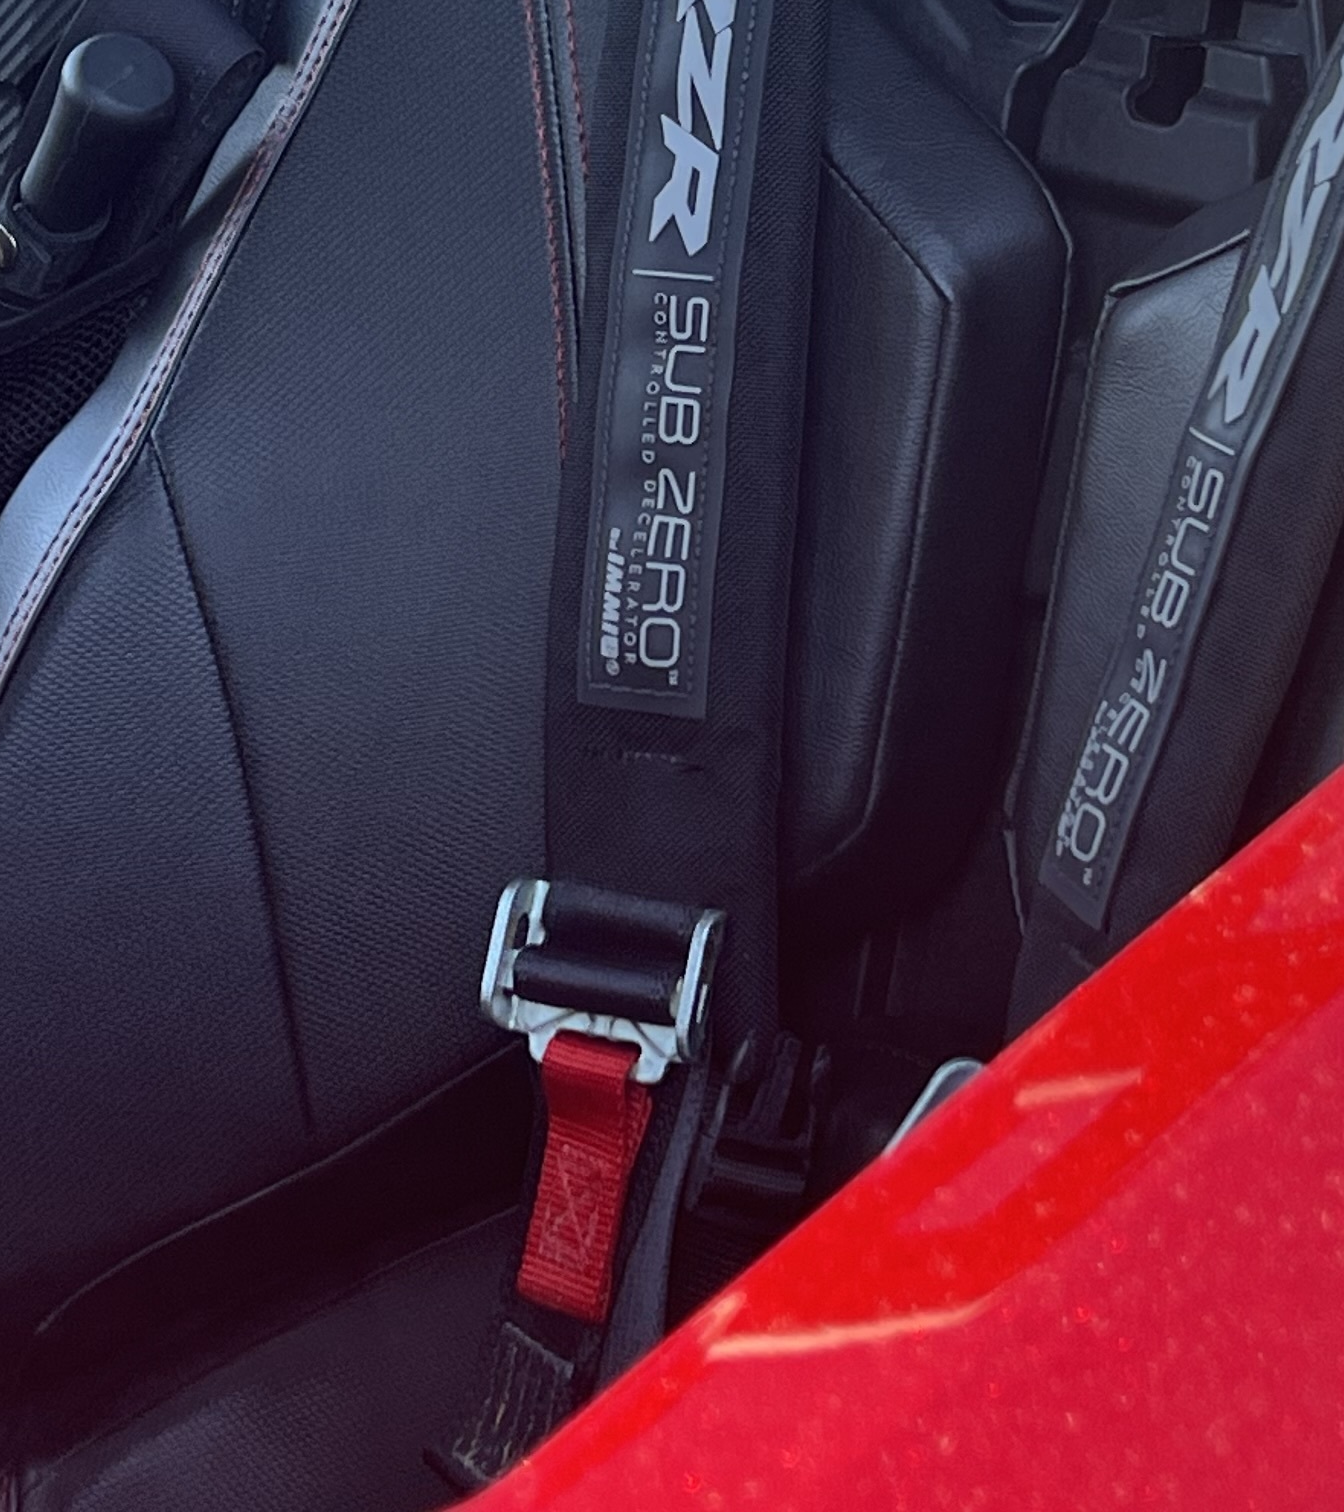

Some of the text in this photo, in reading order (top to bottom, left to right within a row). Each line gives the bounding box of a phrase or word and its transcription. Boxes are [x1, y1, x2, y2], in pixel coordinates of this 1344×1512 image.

[658, 295, 710, 446] SUB
[623, 292, 668, 665] CONTROLLED DECELERATOR
[1152, 460, 1225, 628] SUB
